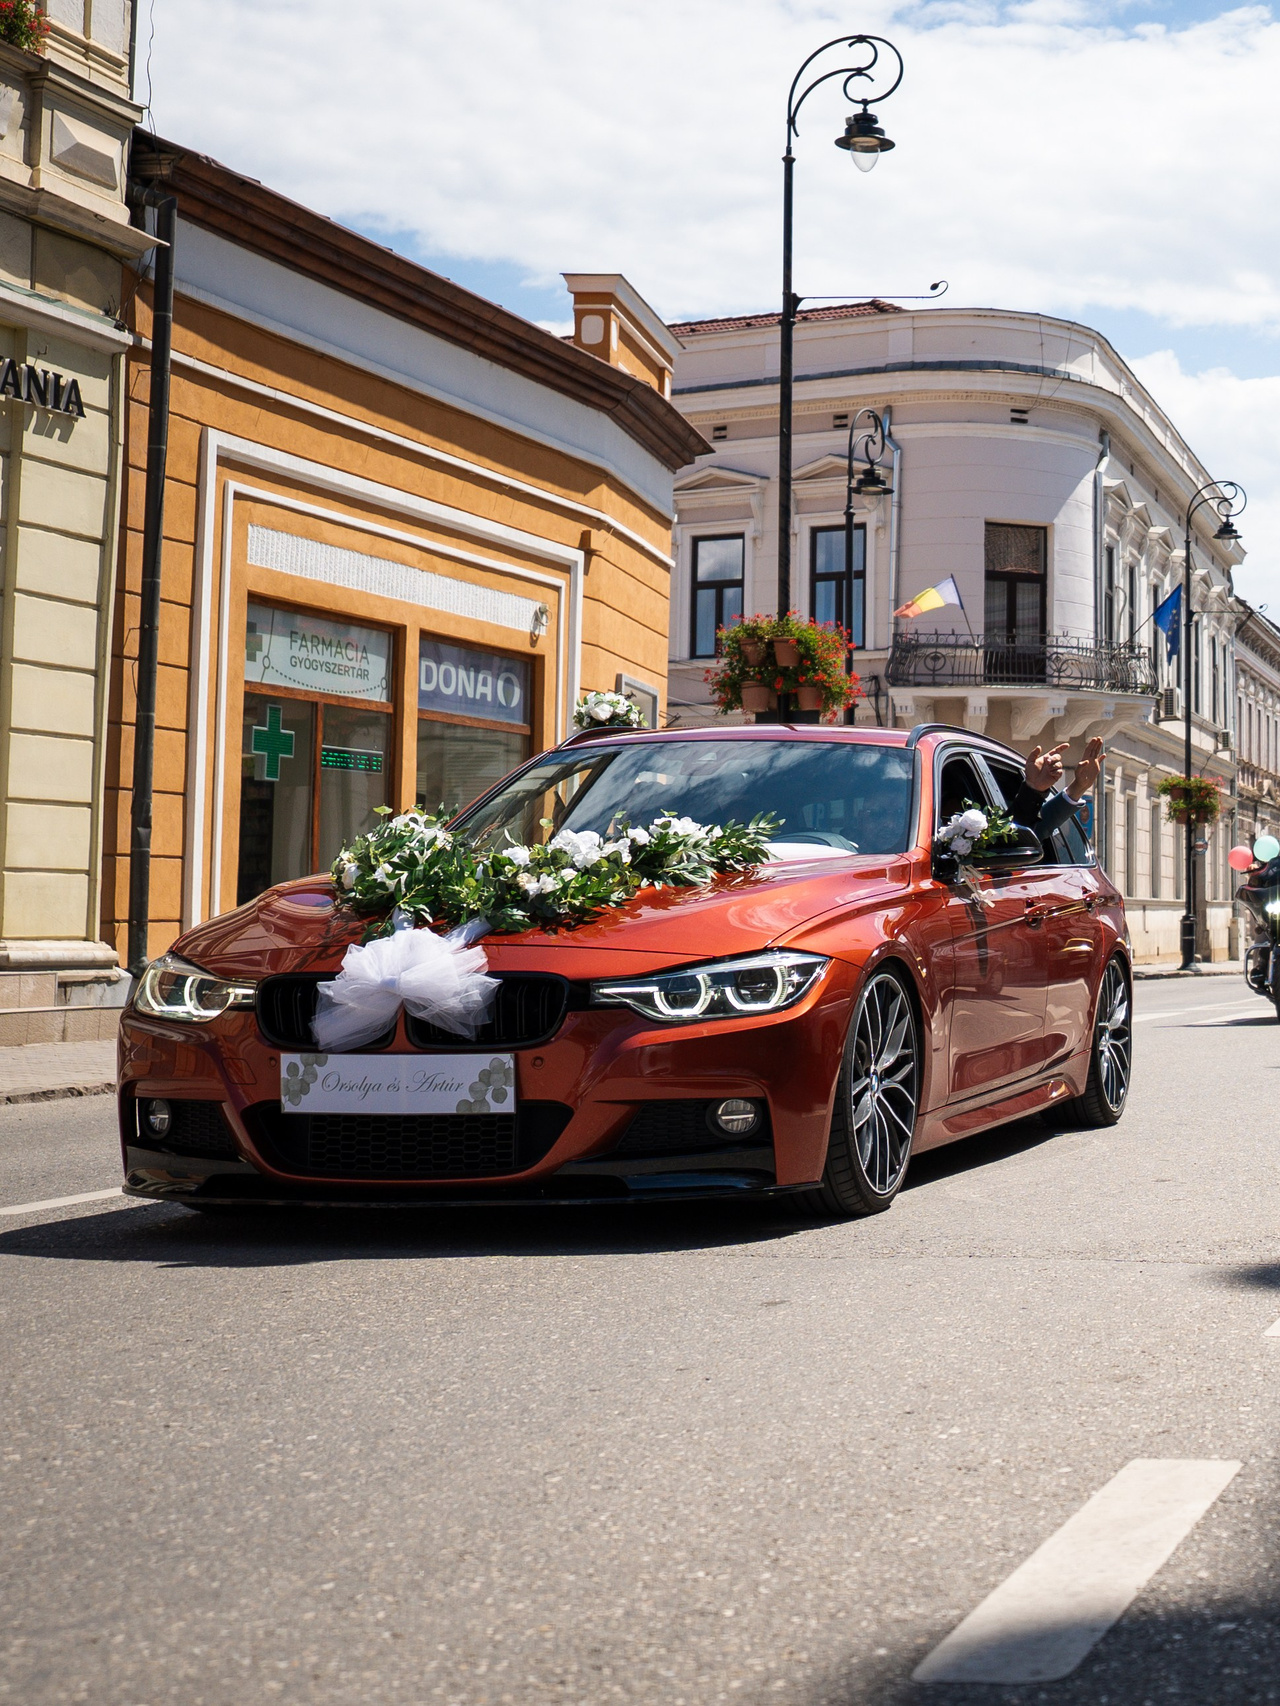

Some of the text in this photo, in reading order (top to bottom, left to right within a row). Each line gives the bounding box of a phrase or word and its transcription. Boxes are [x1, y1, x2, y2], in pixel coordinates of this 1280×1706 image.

[0, 355, 86, 419] ANIA
[289, 630, 370, 665] FARMACIA
[289, 654, 370, 681] GYÓGYSZERTÁR
[420, 657, 492, 702] DONA
[321, 1070, 464, 1101] Orsolya és Artúr
